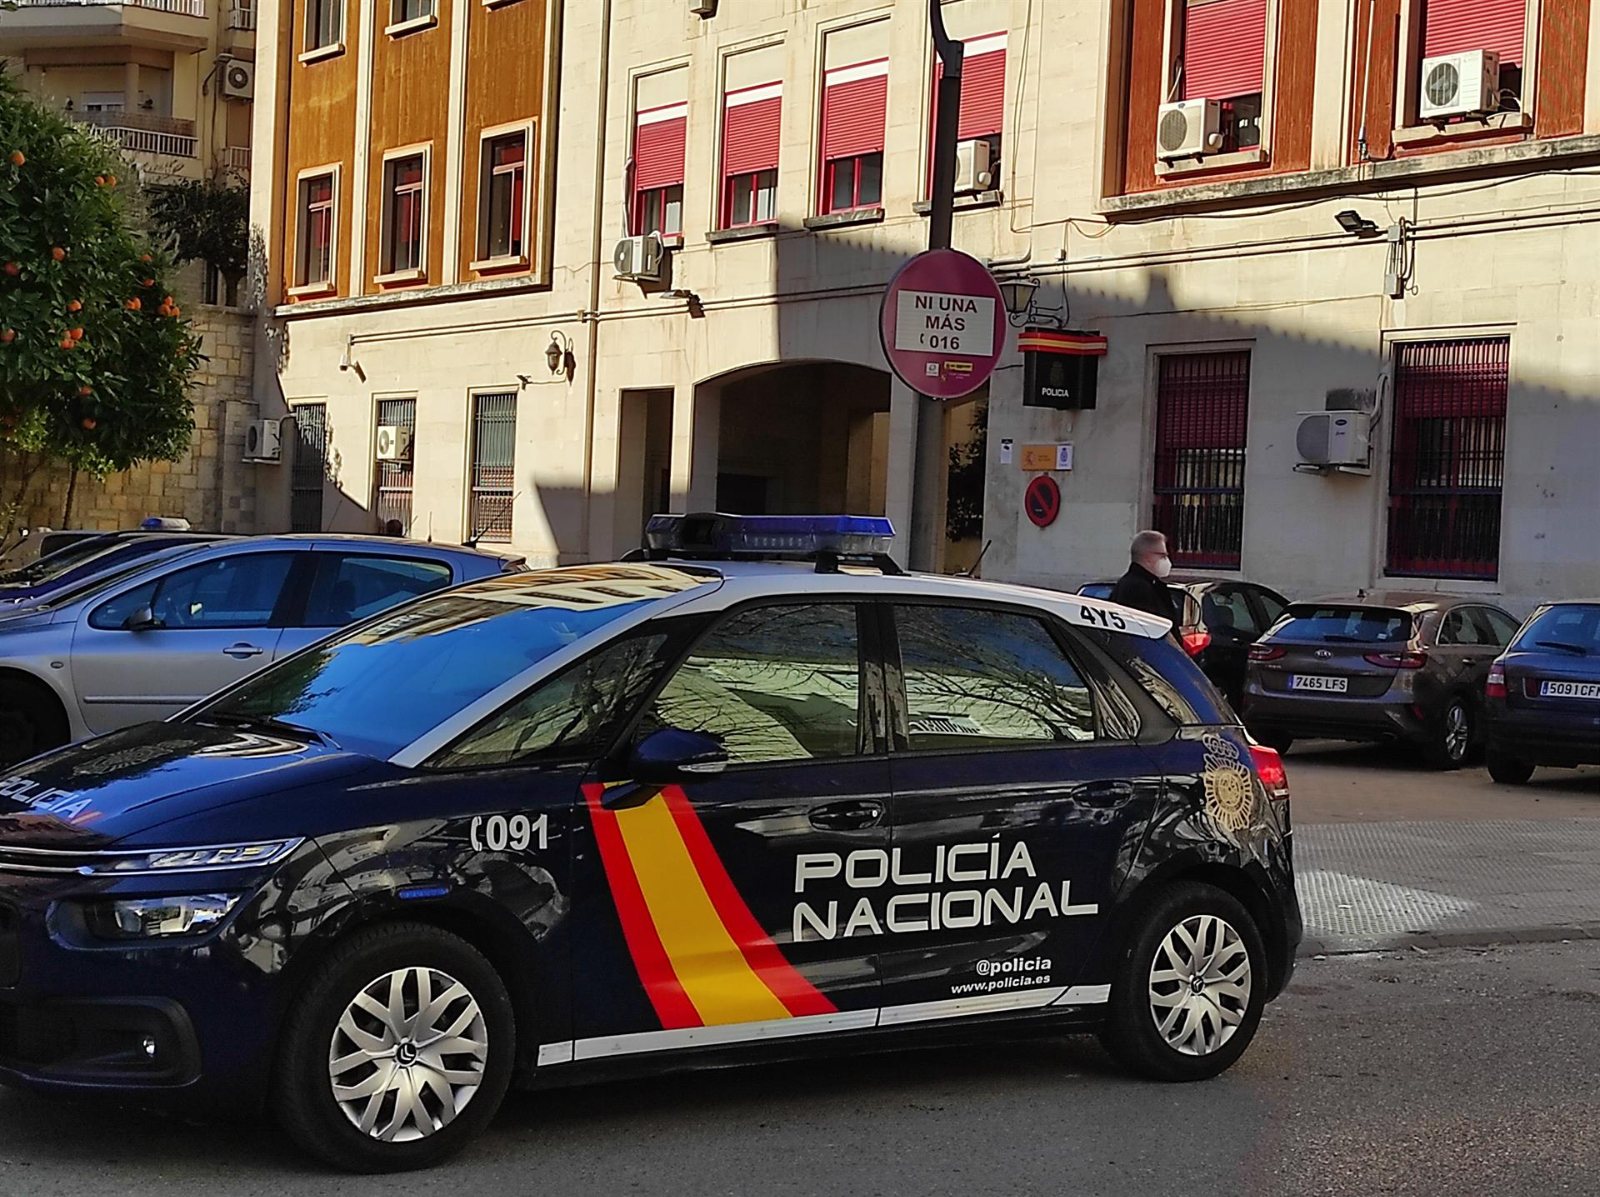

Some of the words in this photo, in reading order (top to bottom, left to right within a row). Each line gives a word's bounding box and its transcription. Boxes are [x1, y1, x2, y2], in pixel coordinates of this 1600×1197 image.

[915, 295, 933, 310] NI
[939, 297, 977, 313] UNA
[925, 313, 966, 332] MÁS
[929, 334, 960, 350] 016
[1041, 386, 1070, 398] POLICIA
[1080, 605, 1126, 630] 4Y5
[1296, 677, 1322, 689] 7465
[1325, 679, 1346, 690] LFS
[486, 813, 548, 851] 091
[795, 833, 1037, 893] POLICÍA
[792, 880, 1099, 942] NACIONAL
[976, 956, 1052, 977] @policia
[951, 974, 1051, 994] www.policia.es
